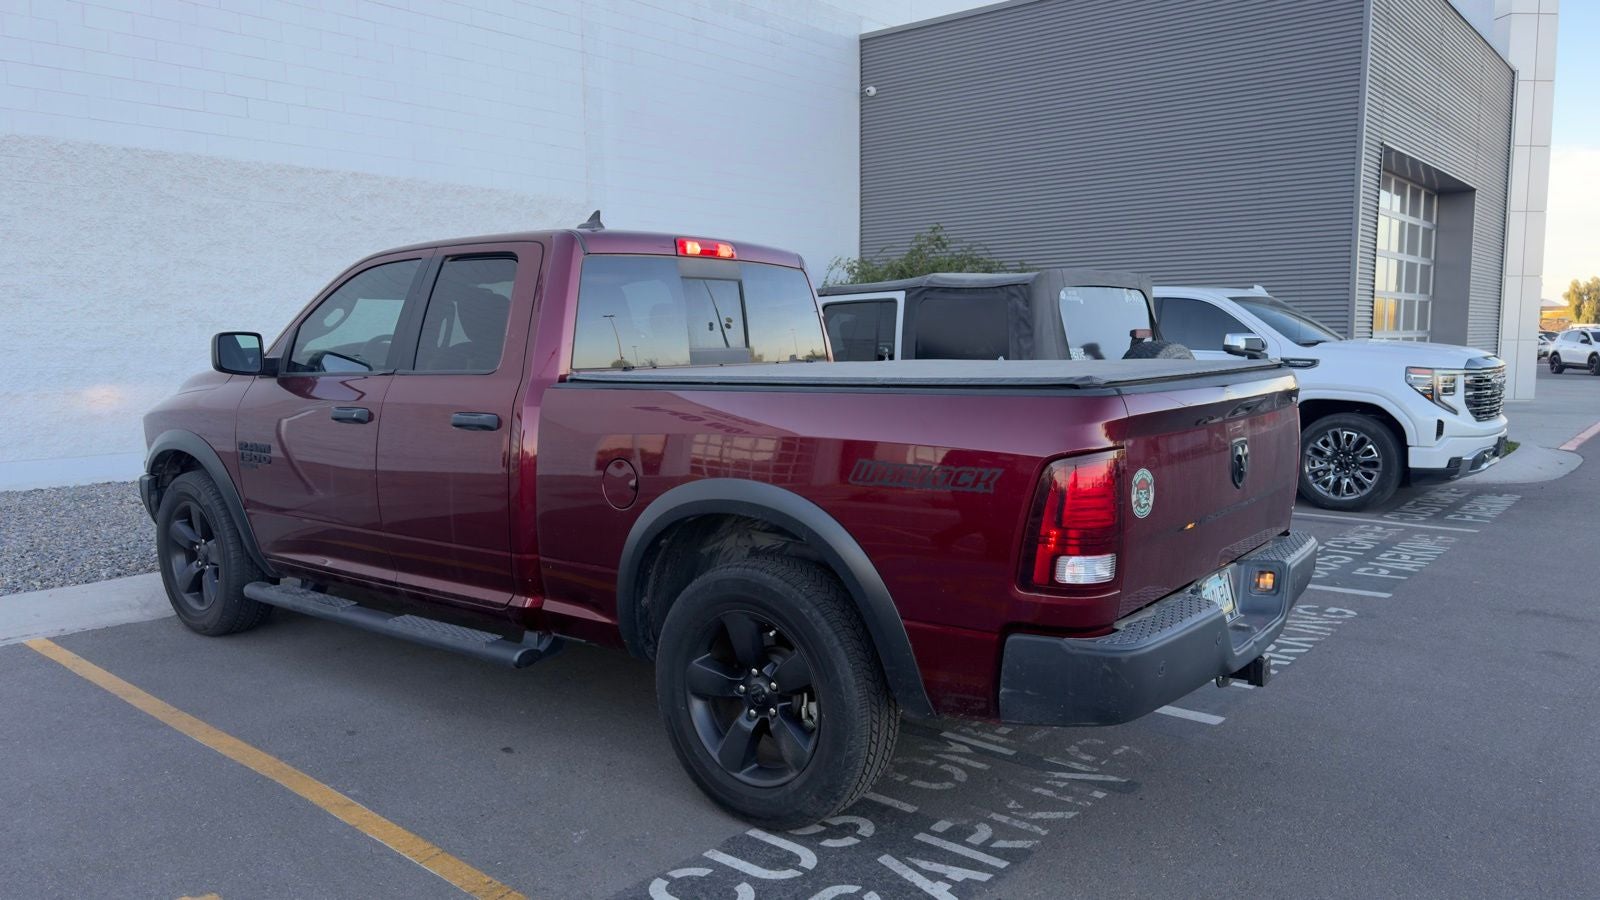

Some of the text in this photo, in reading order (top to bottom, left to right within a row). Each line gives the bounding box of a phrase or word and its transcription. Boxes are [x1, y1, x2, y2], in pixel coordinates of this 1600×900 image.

[241, 452, 272, 465] 1500
[1352, 534, 1458, 580] PARKING
[649, 719, 1052, 900] CUSTOME
